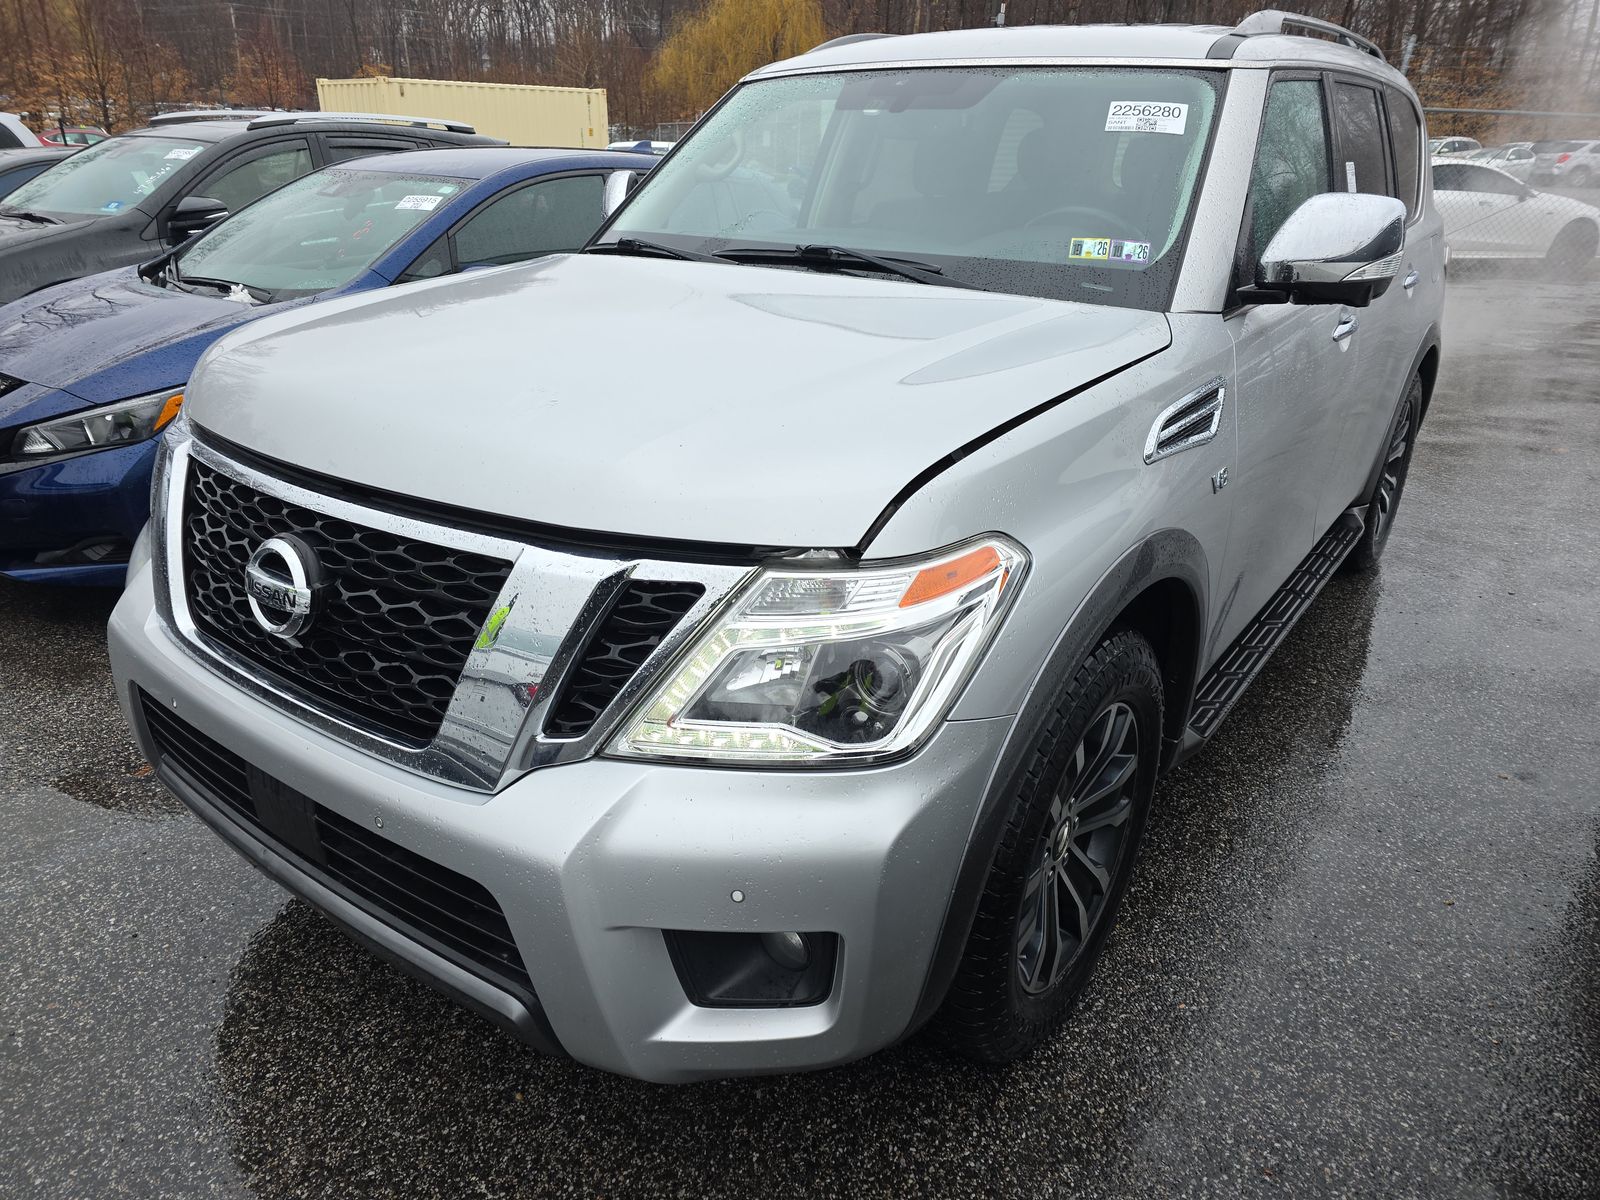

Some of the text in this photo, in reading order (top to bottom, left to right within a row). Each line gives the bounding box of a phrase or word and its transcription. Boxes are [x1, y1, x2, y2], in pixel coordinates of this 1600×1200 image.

[1112, 104, 1182, 119] 2256280
[1097, 241, 1108, 256] 26
[1137, 244, 1149, 260] 26
[246, 577, 297, 609] NISSAN
